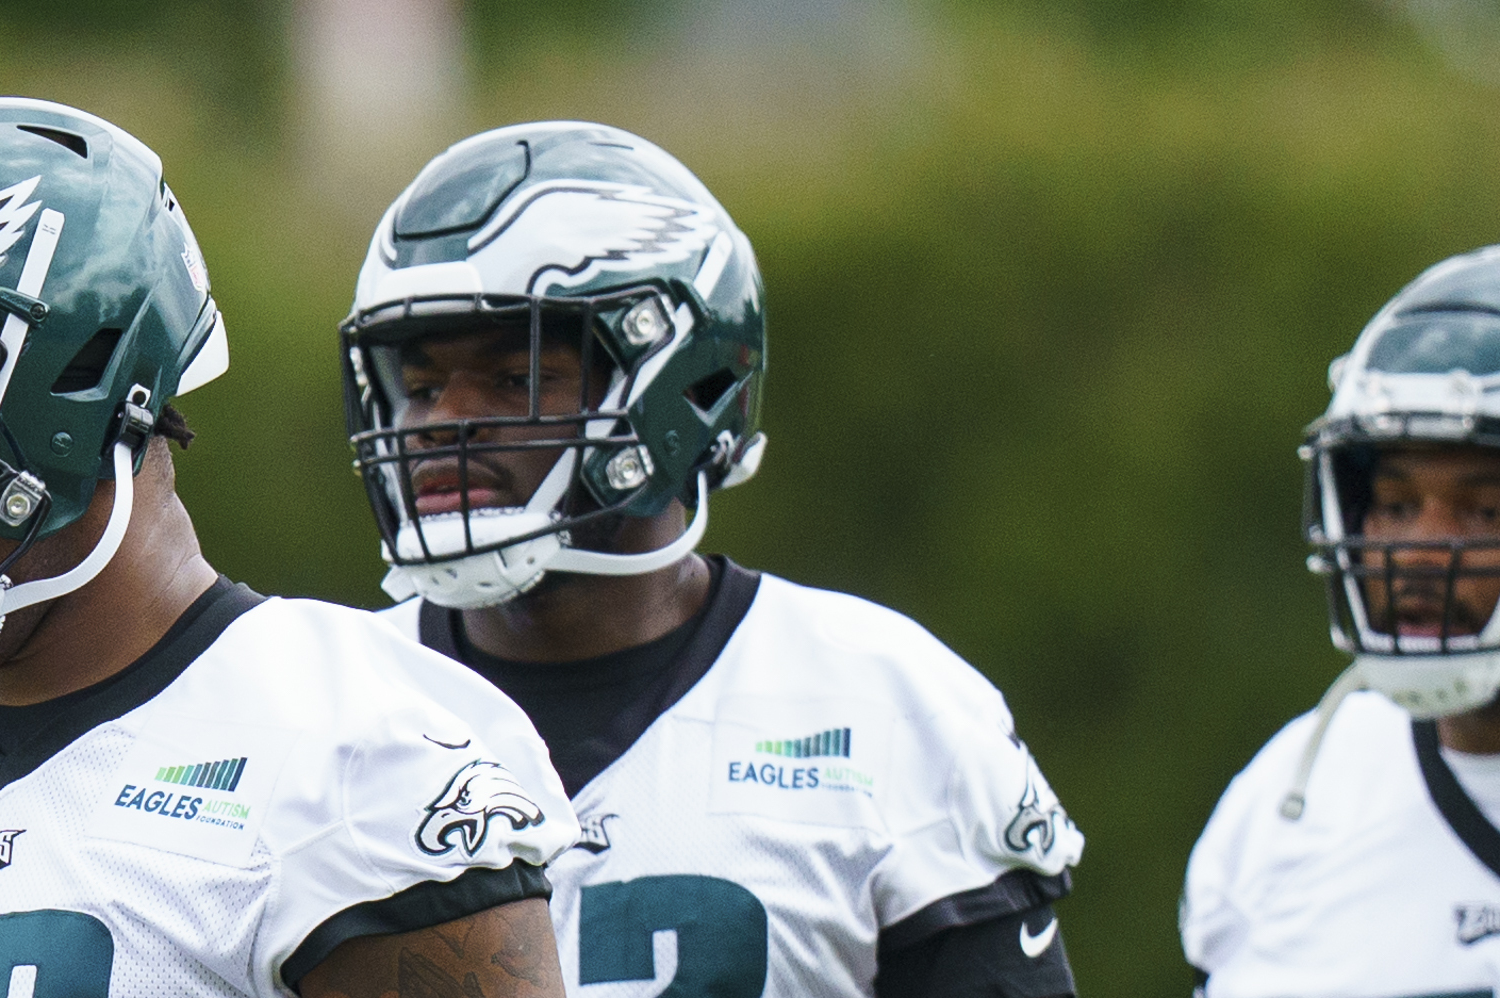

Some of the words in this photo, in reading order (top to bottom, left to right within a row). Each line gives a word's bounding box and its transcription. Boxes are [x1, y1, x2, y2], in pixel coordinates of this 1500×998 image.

[728, 761, 819, 789] EAGLES
[114, 784, 203, 820] EAGLES
[202, 799, 251, 820] AUTISM
[196, 815, 244, 830] FOUNDATION
